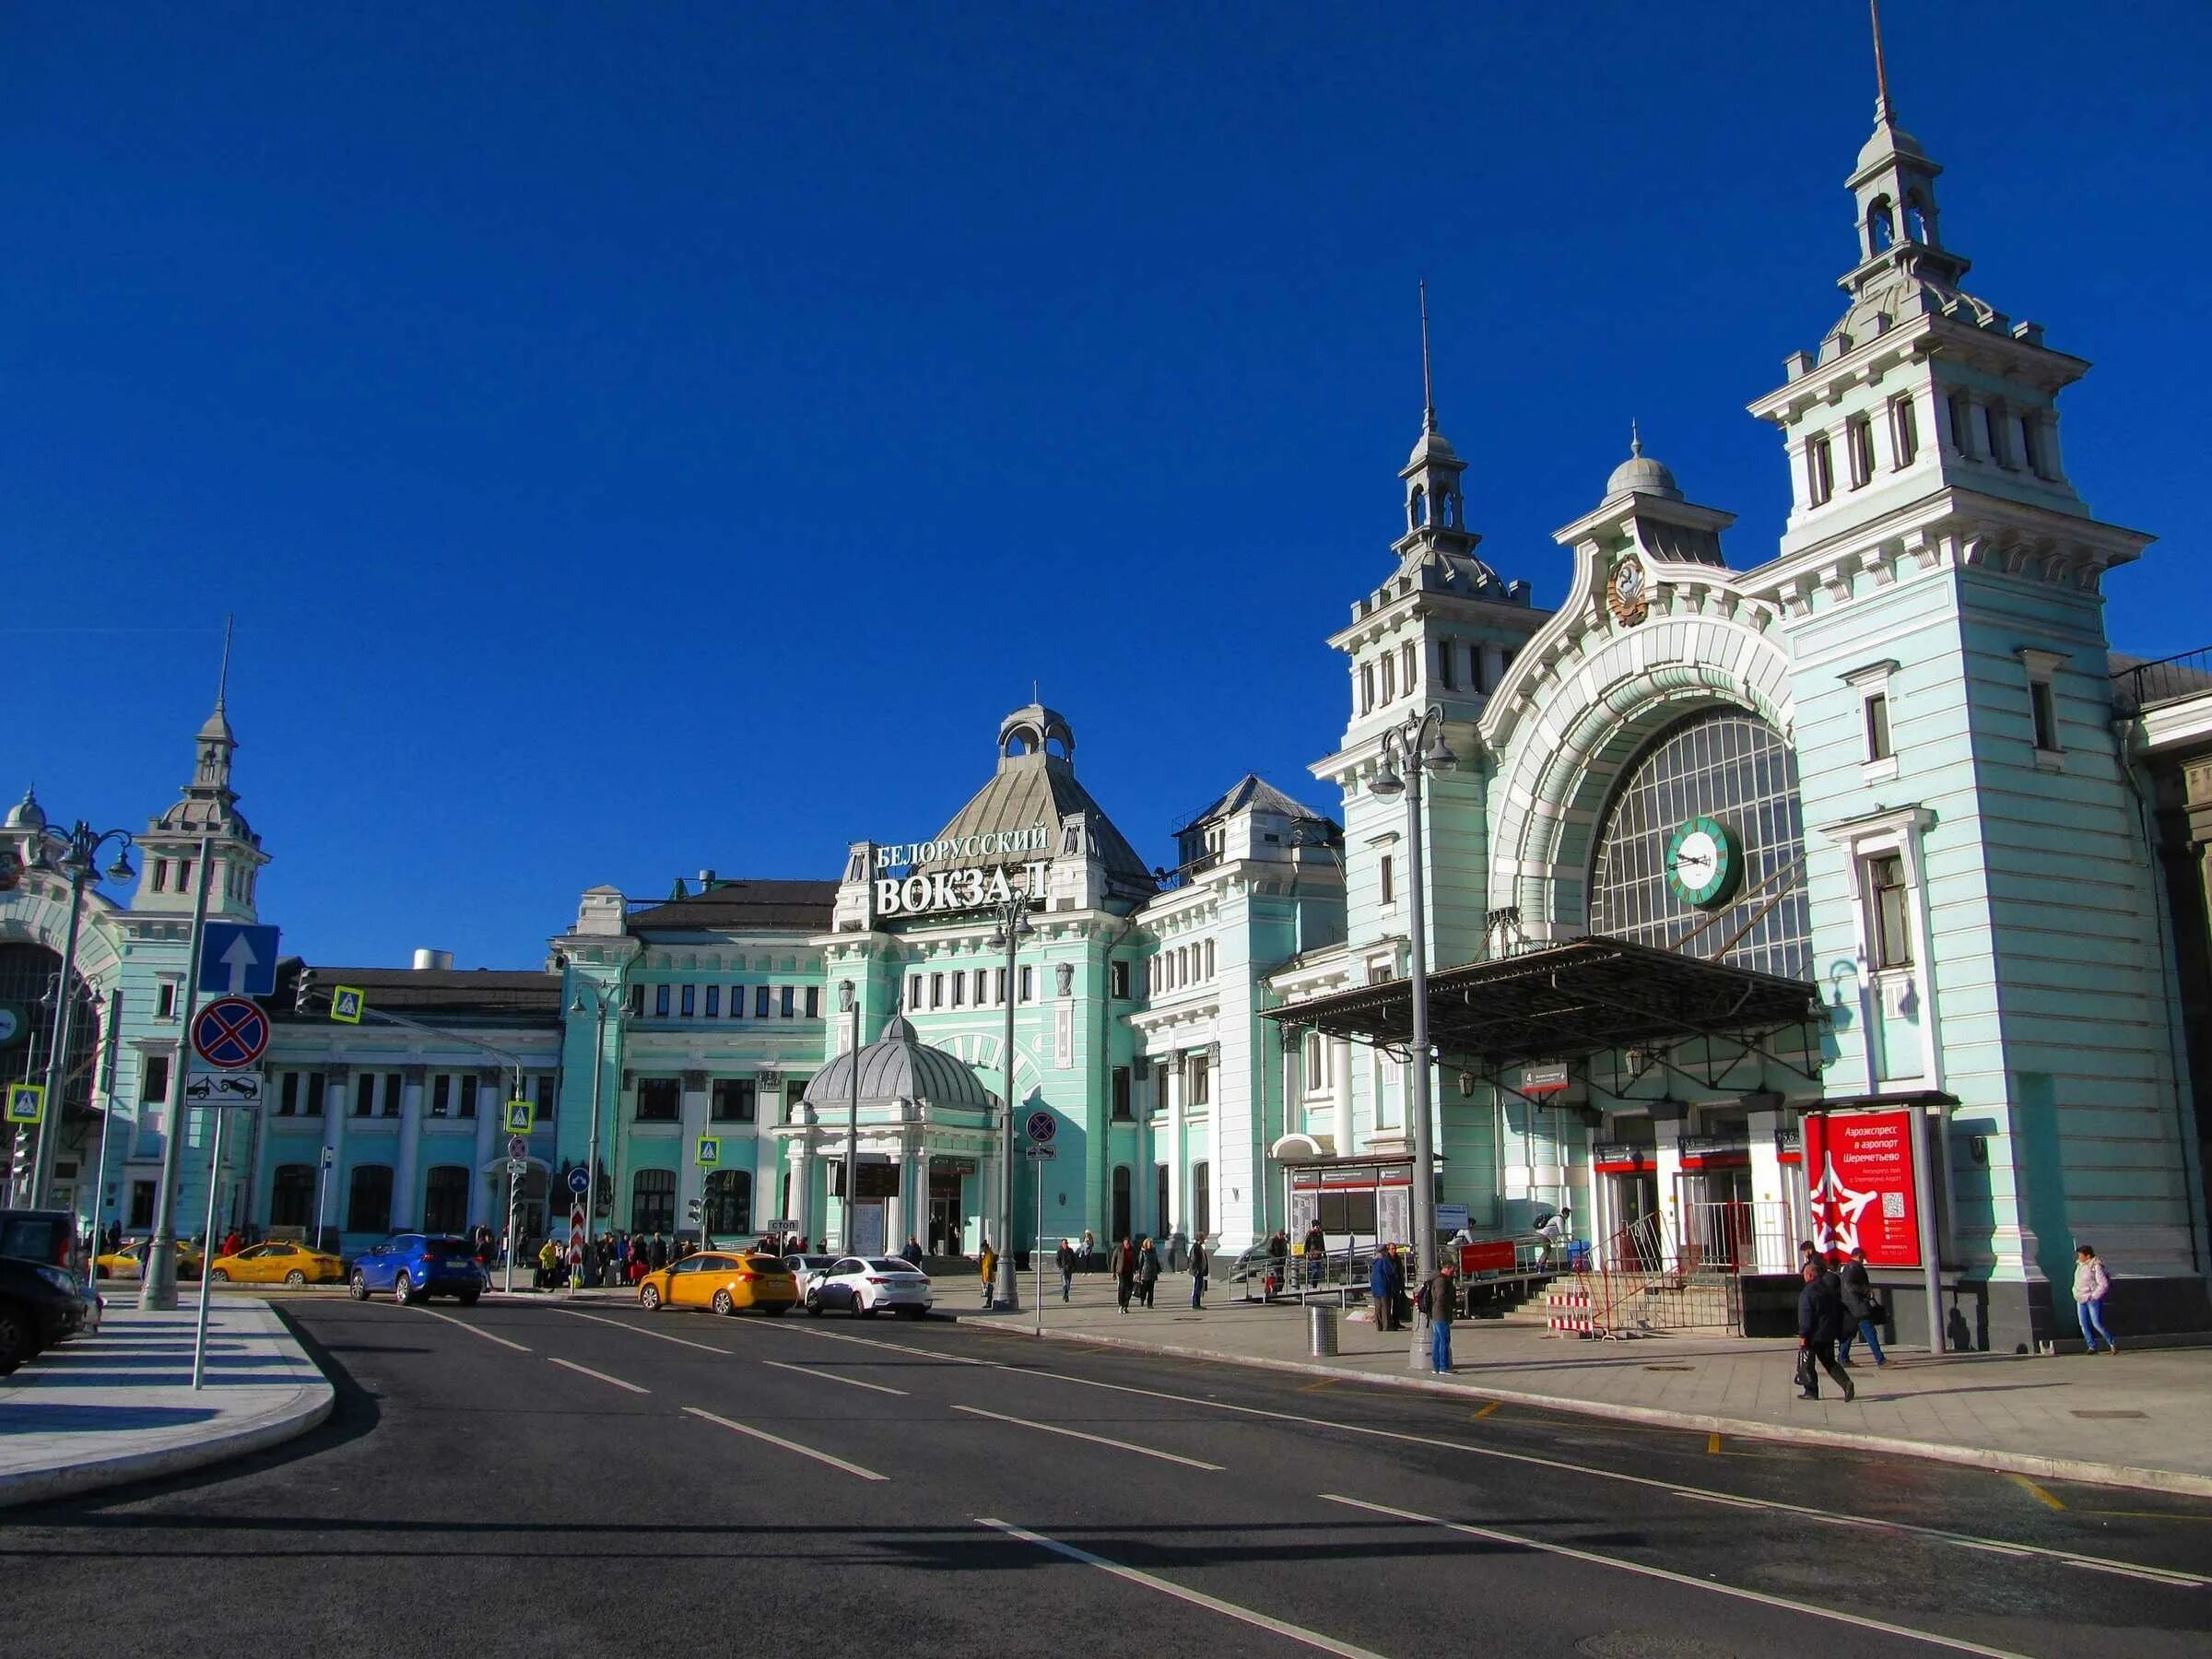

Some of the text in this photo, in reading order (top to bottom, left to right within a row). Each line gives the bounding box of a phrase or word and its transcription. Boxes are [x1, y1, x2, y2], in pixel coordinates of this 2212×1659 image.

[877, 821, 1050, 869] БЕЛОРУССКИЙ
[875, 862, 1048, 915] ВОКЗАЛ
[1845, 1126, 1898, 1137] Аэроэкспресс
[1861, 1139, 1899, 1150] аэропорт
[1843, 1153, 1900, 1164] Шереметьево
